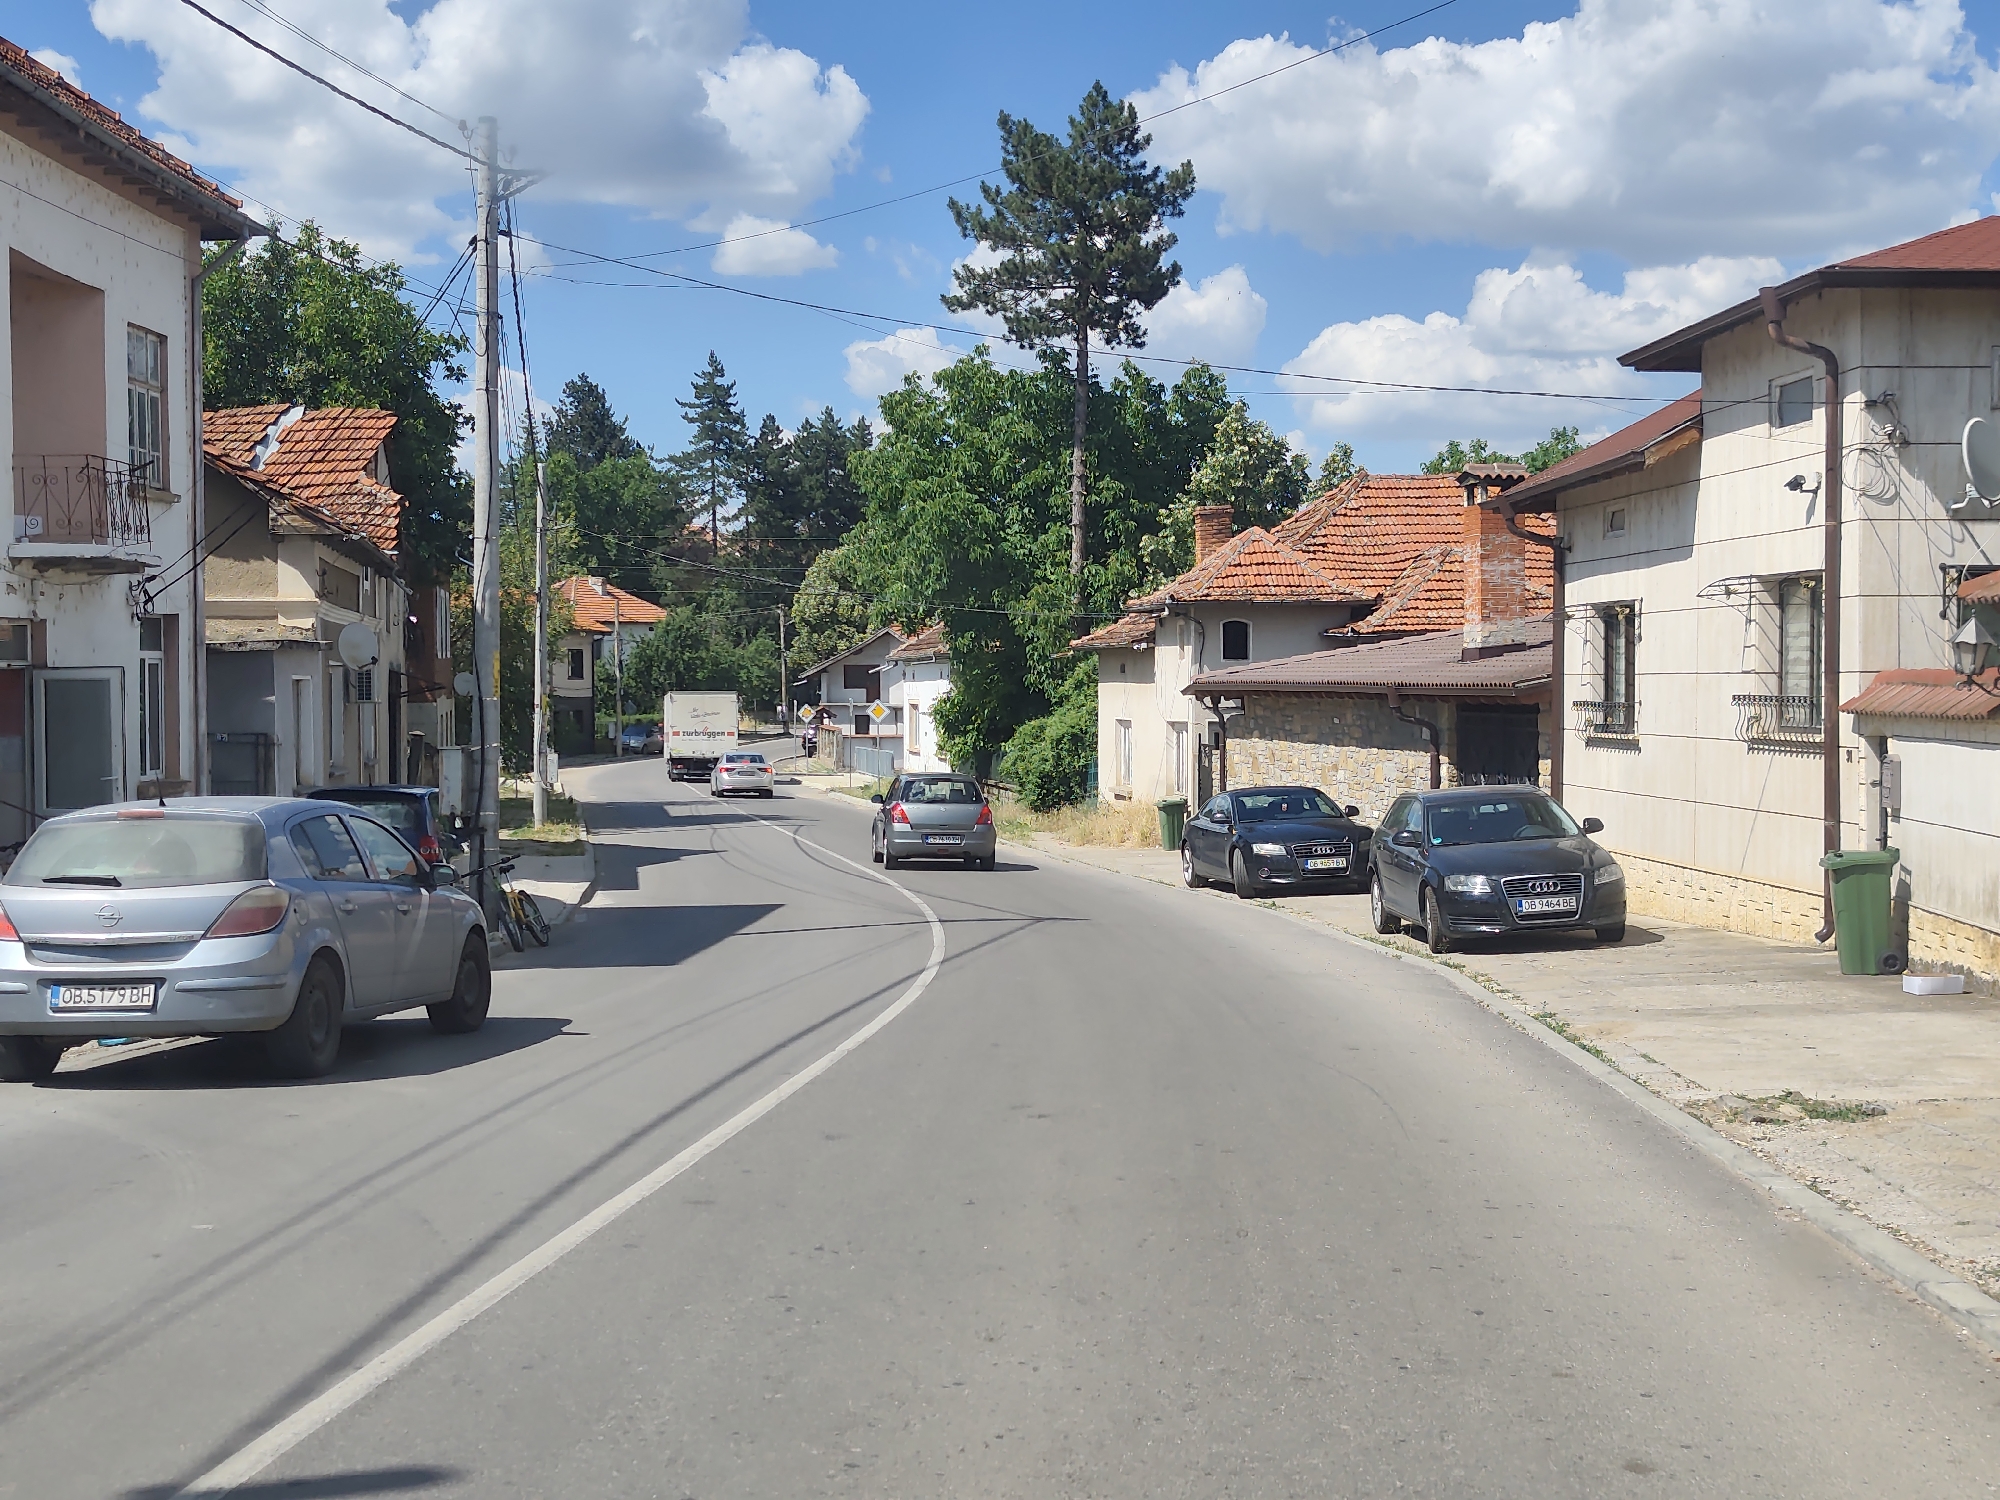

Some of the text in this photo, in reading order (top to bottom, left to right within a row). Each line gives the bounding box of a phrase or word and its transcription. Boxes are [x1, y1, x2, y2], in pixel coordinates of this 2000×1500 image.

[682, 726, 725, 738] zurbrüggen
[1538, 899, 1561, 909] 9464
[1562, 897, 1576, 908] BE
[86, 987, 127, 1004] 5179
[129, 987, 151, 1003] BH
